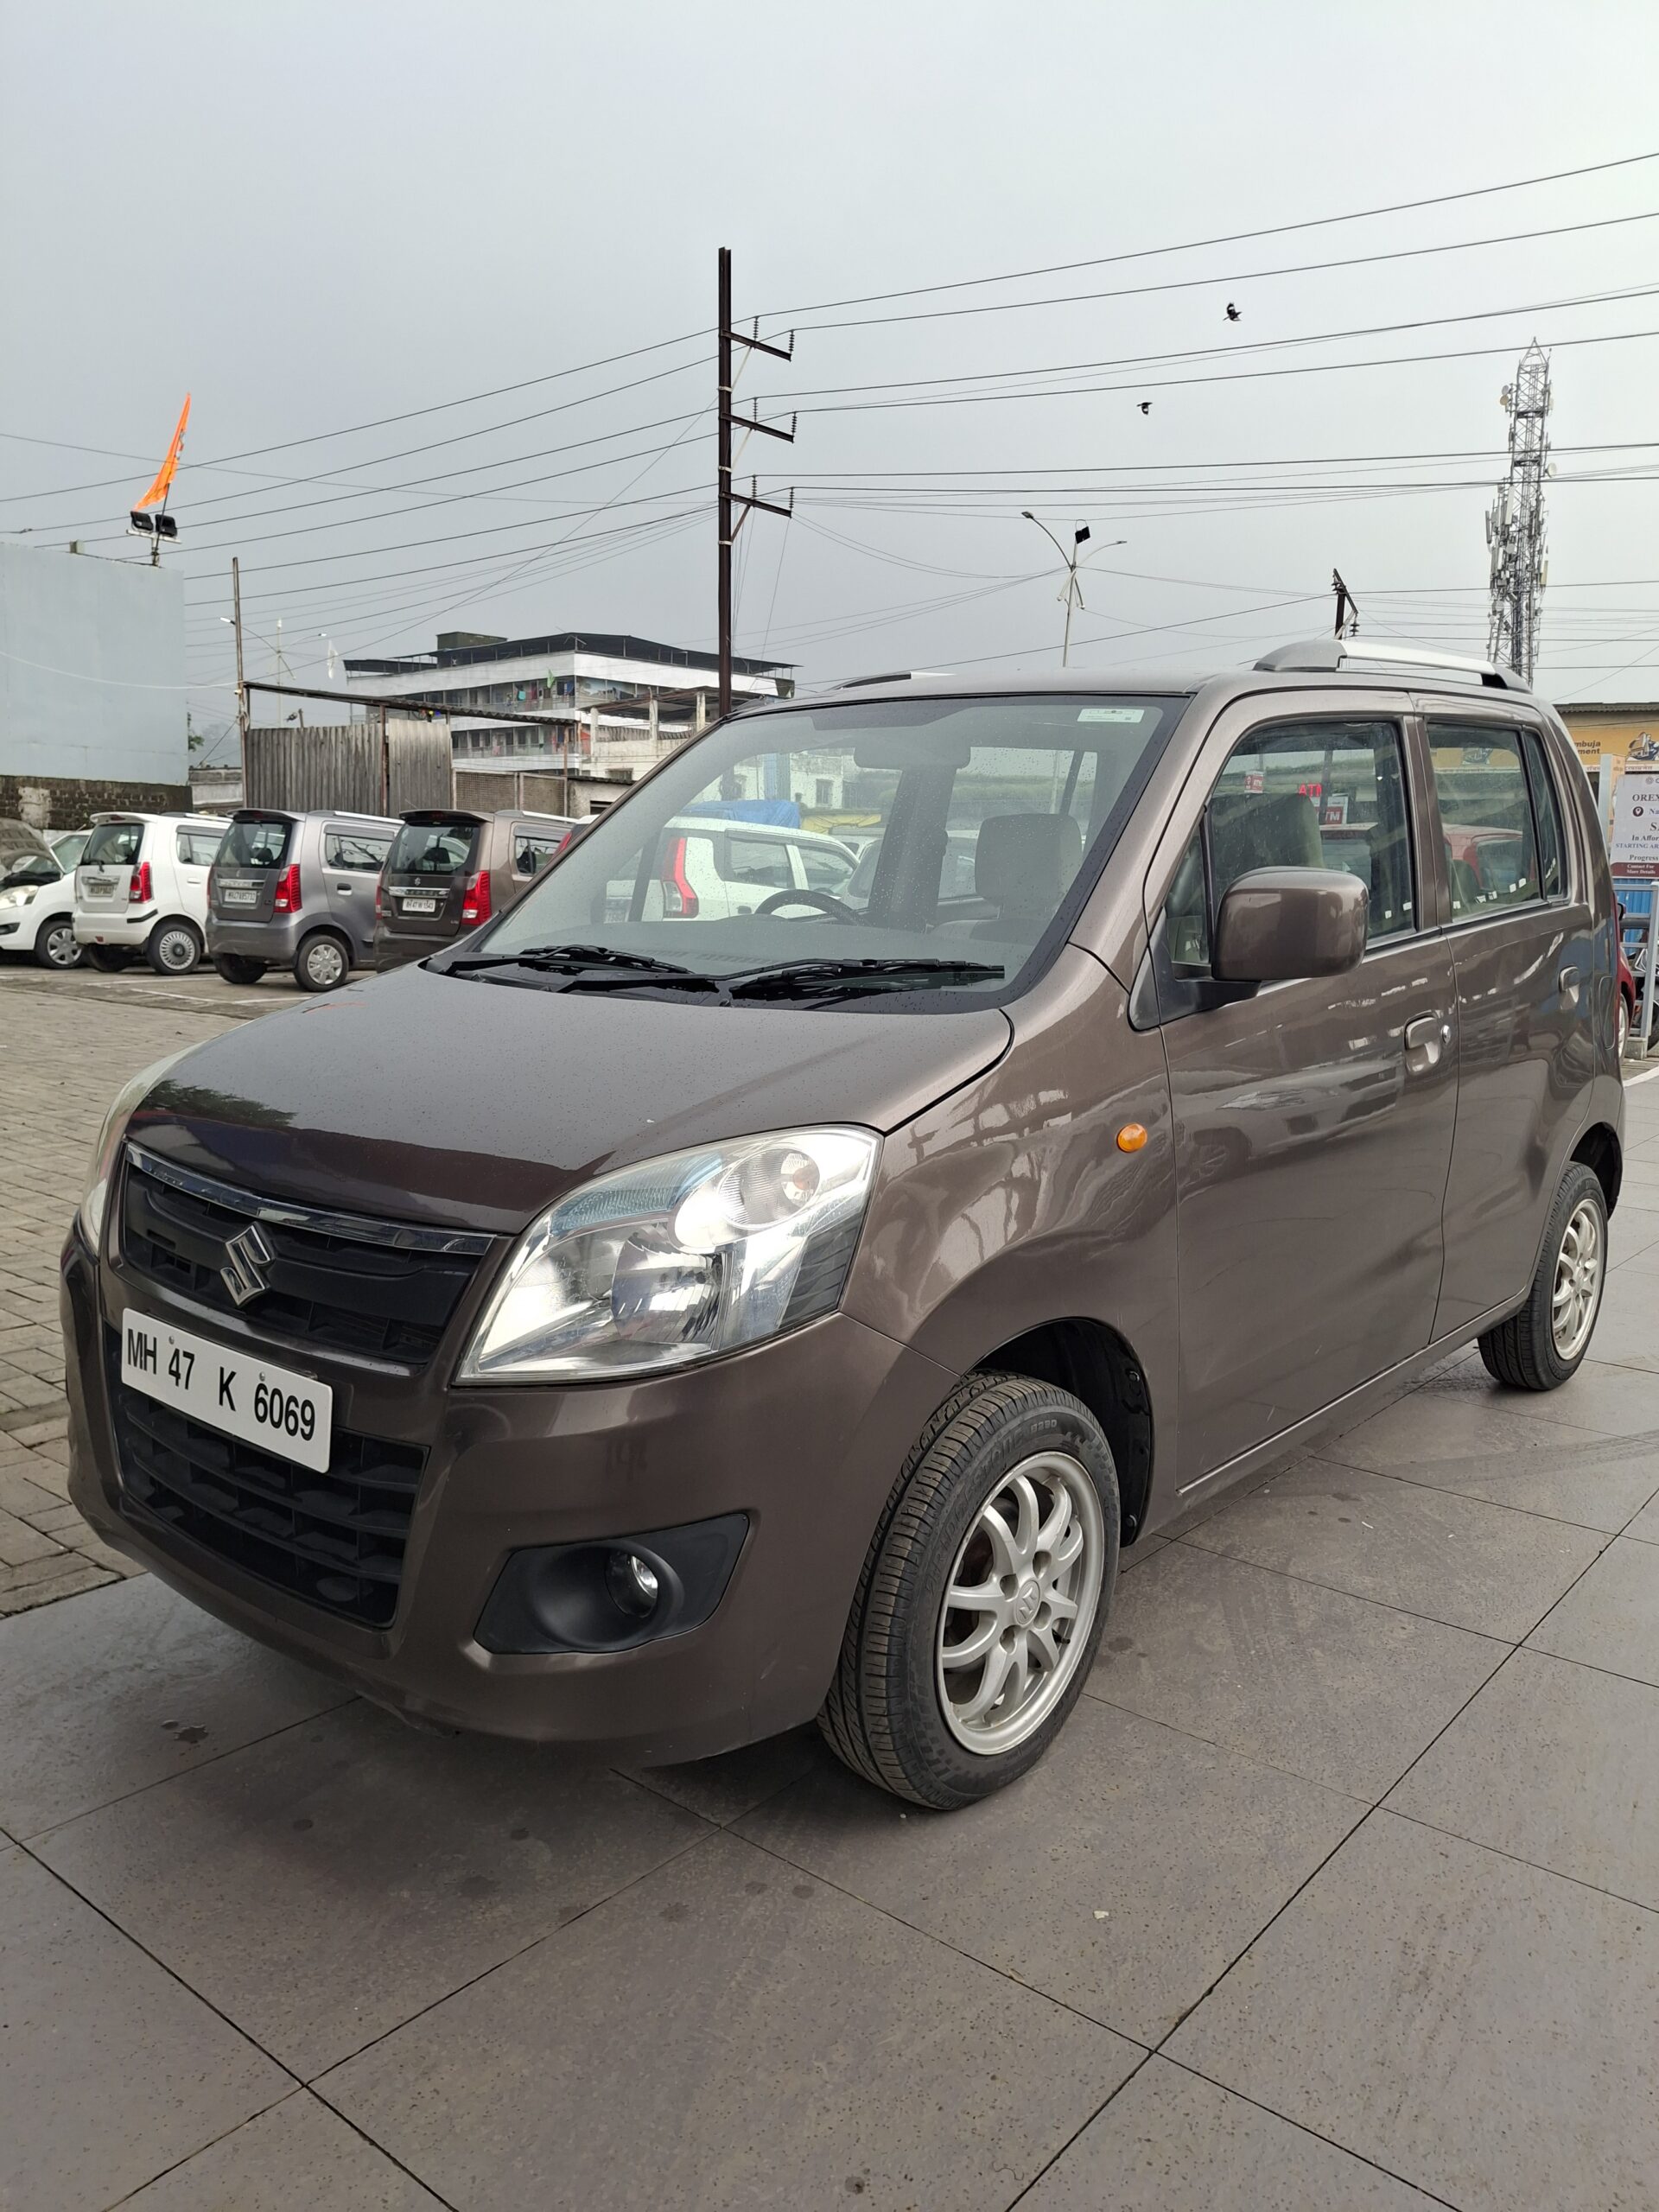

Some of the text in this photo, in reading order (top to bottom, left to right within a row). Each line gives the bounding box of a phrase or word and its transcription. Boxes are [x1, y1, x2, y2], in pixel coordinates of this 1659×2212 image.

[1649, 822, 1659, 831] S
[127, 1329, 315, 1441] MH 47 K 6069
